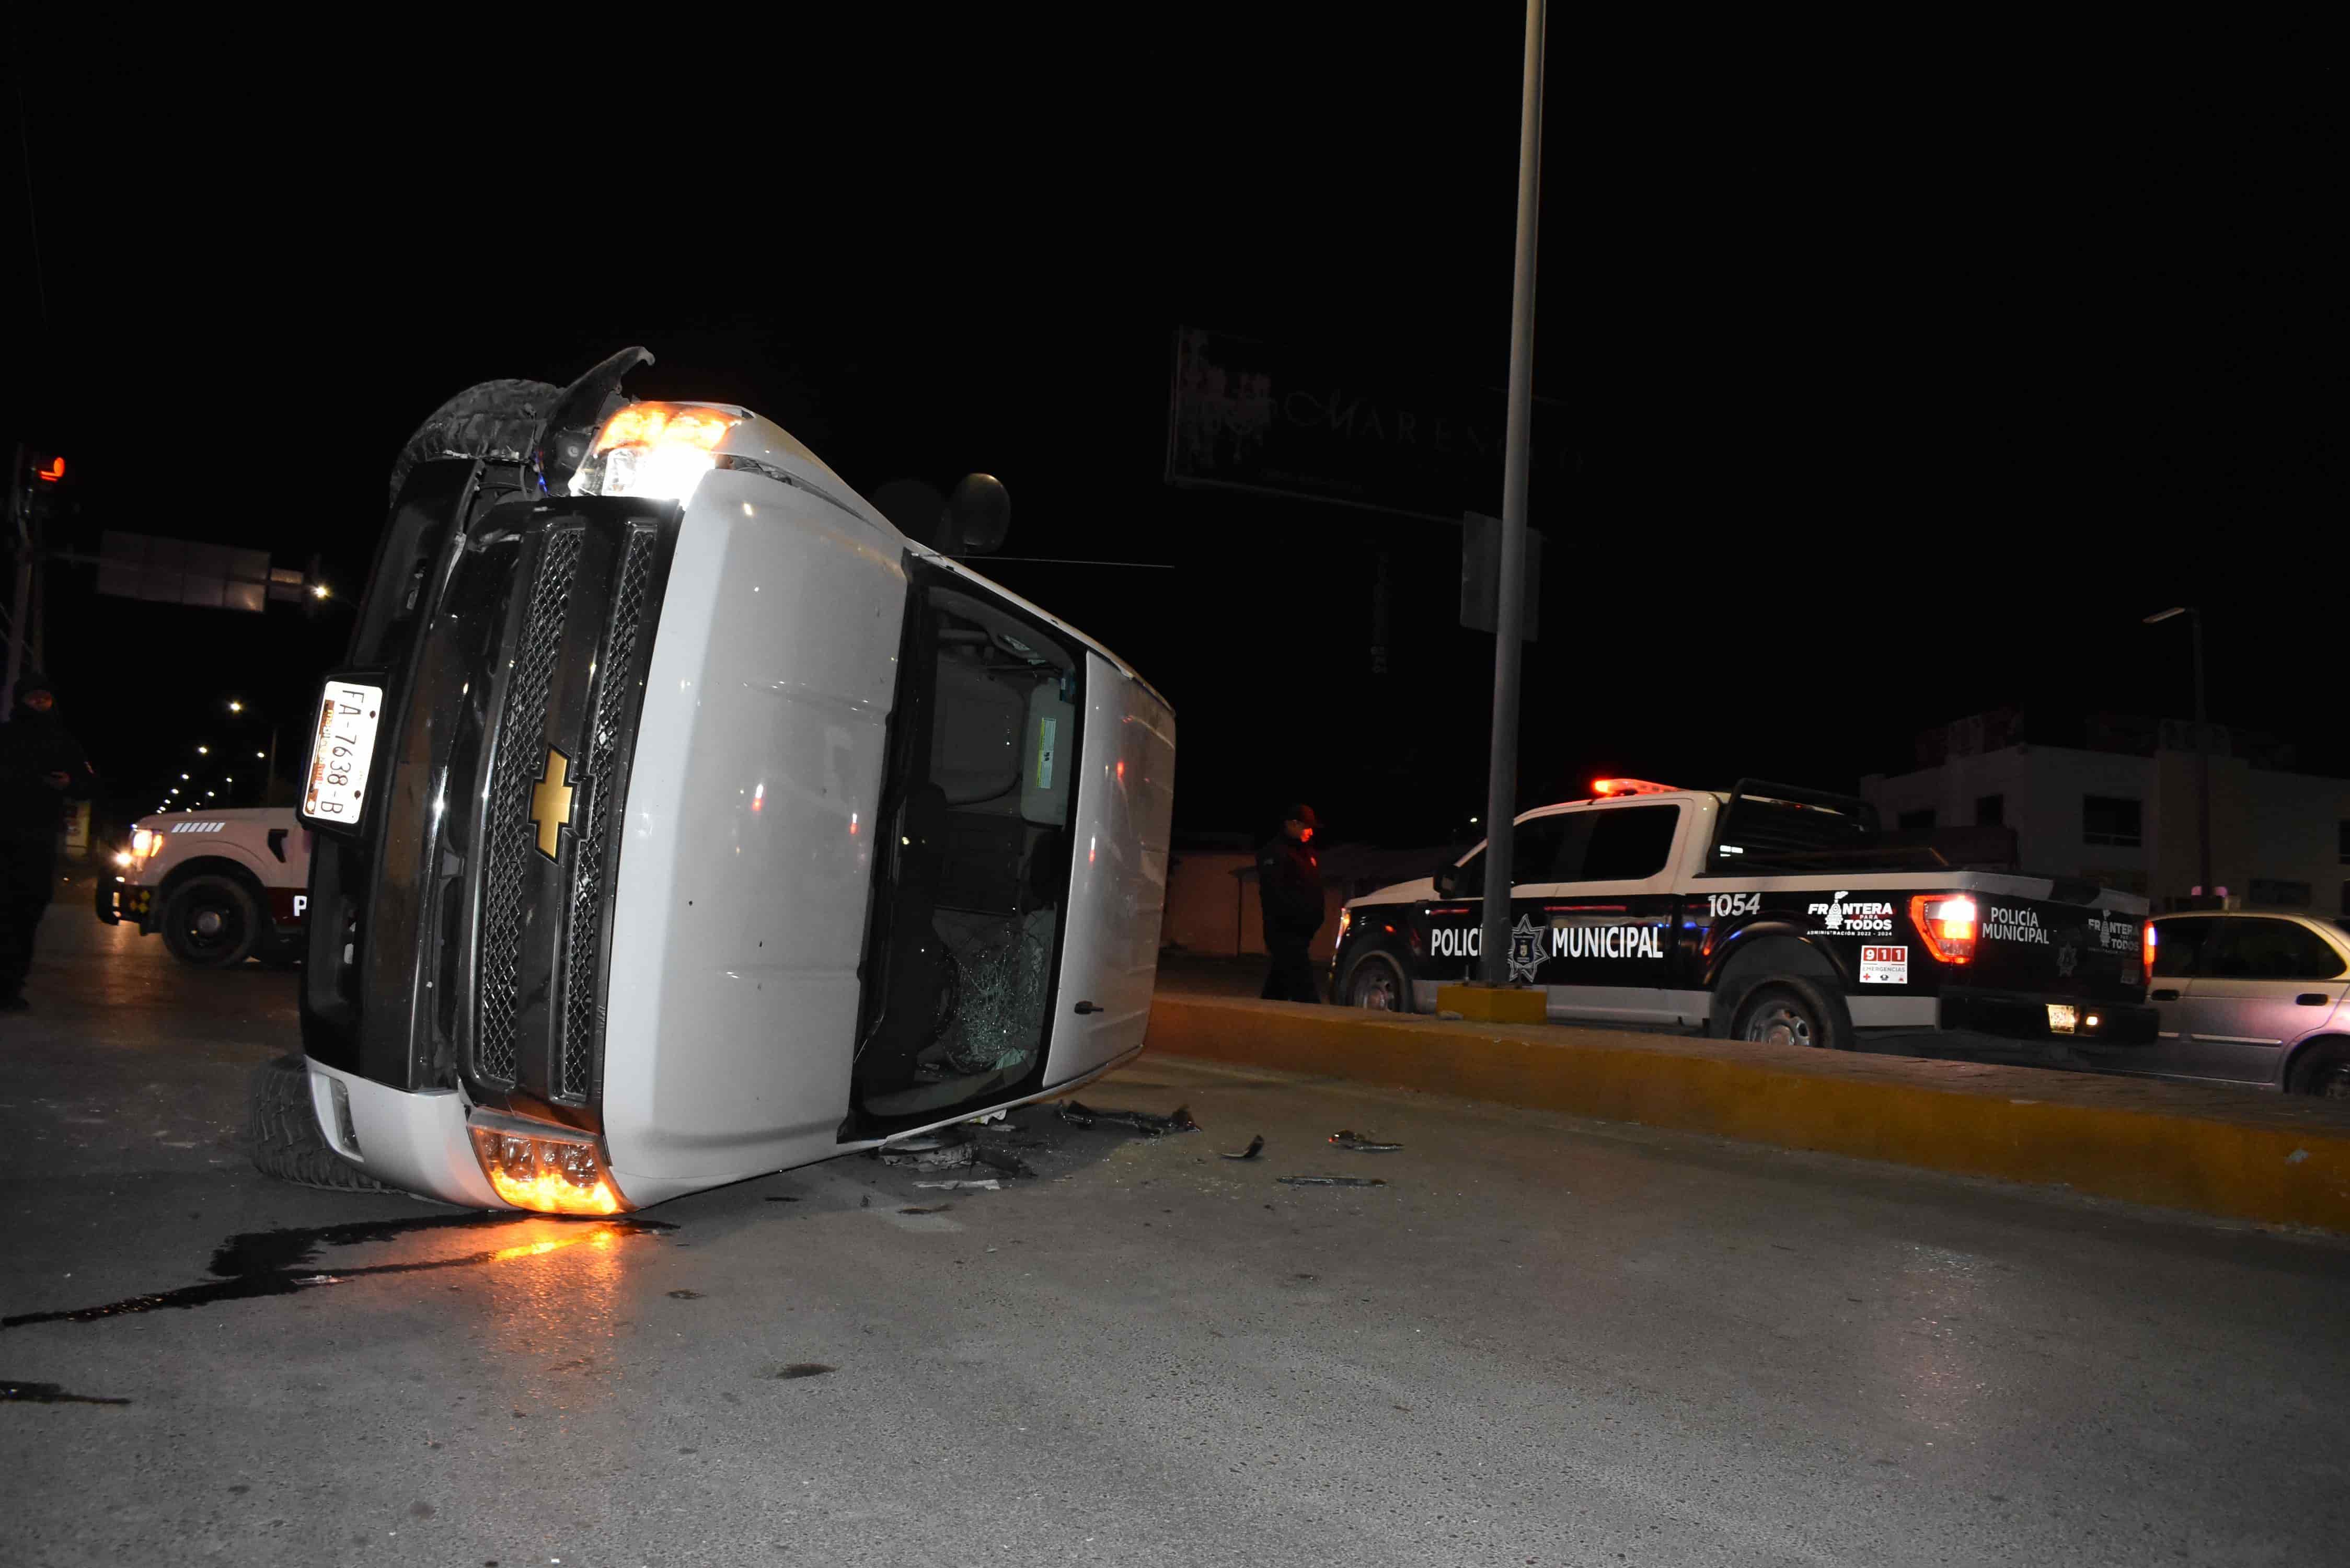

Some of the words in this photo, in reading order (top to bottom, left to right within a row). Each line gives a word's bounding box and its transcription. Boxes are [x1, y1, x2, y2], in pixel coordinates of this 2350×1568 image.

[320, 690, 365, 814] FA-7638-B
[1707, 893, 1761, 917] 1054
[1844, 919, 1892, 930] TODOS
[1991, 907, 2038, 927] POLICÍA
[1431, 923, 1483, 956] POLICÍ
[1552, 926, 1664, 958] MUNICIPAL
[1982, 923, 2049, 944] MUNICIPAL
[1866, 949, 1901, 960] 911
